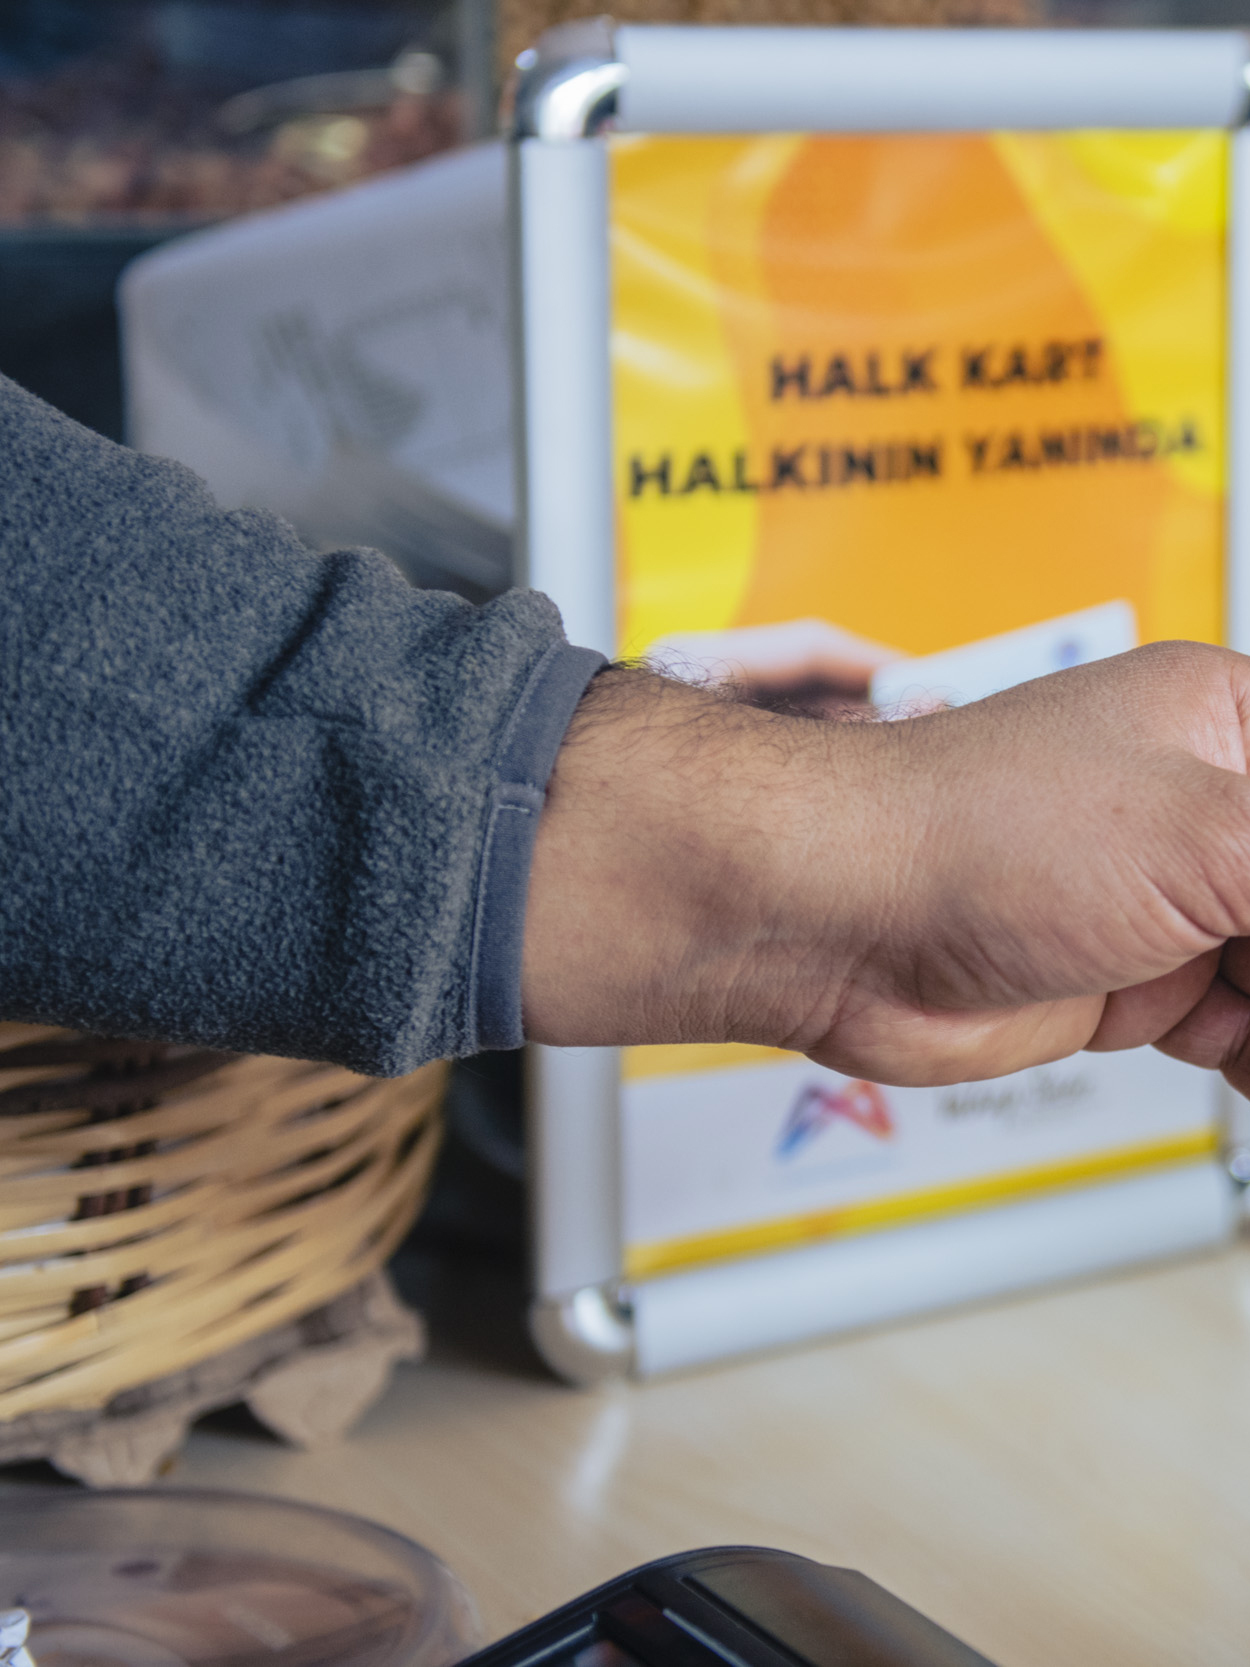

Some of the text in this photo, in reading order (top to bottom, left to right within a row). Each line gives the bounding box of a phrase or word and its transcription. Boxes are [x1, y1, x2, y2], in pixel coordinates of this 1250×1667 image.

[769, 338, 1106, 401] HALK KART
[629, 419, 1203, 497] HALKININ YANINDA
